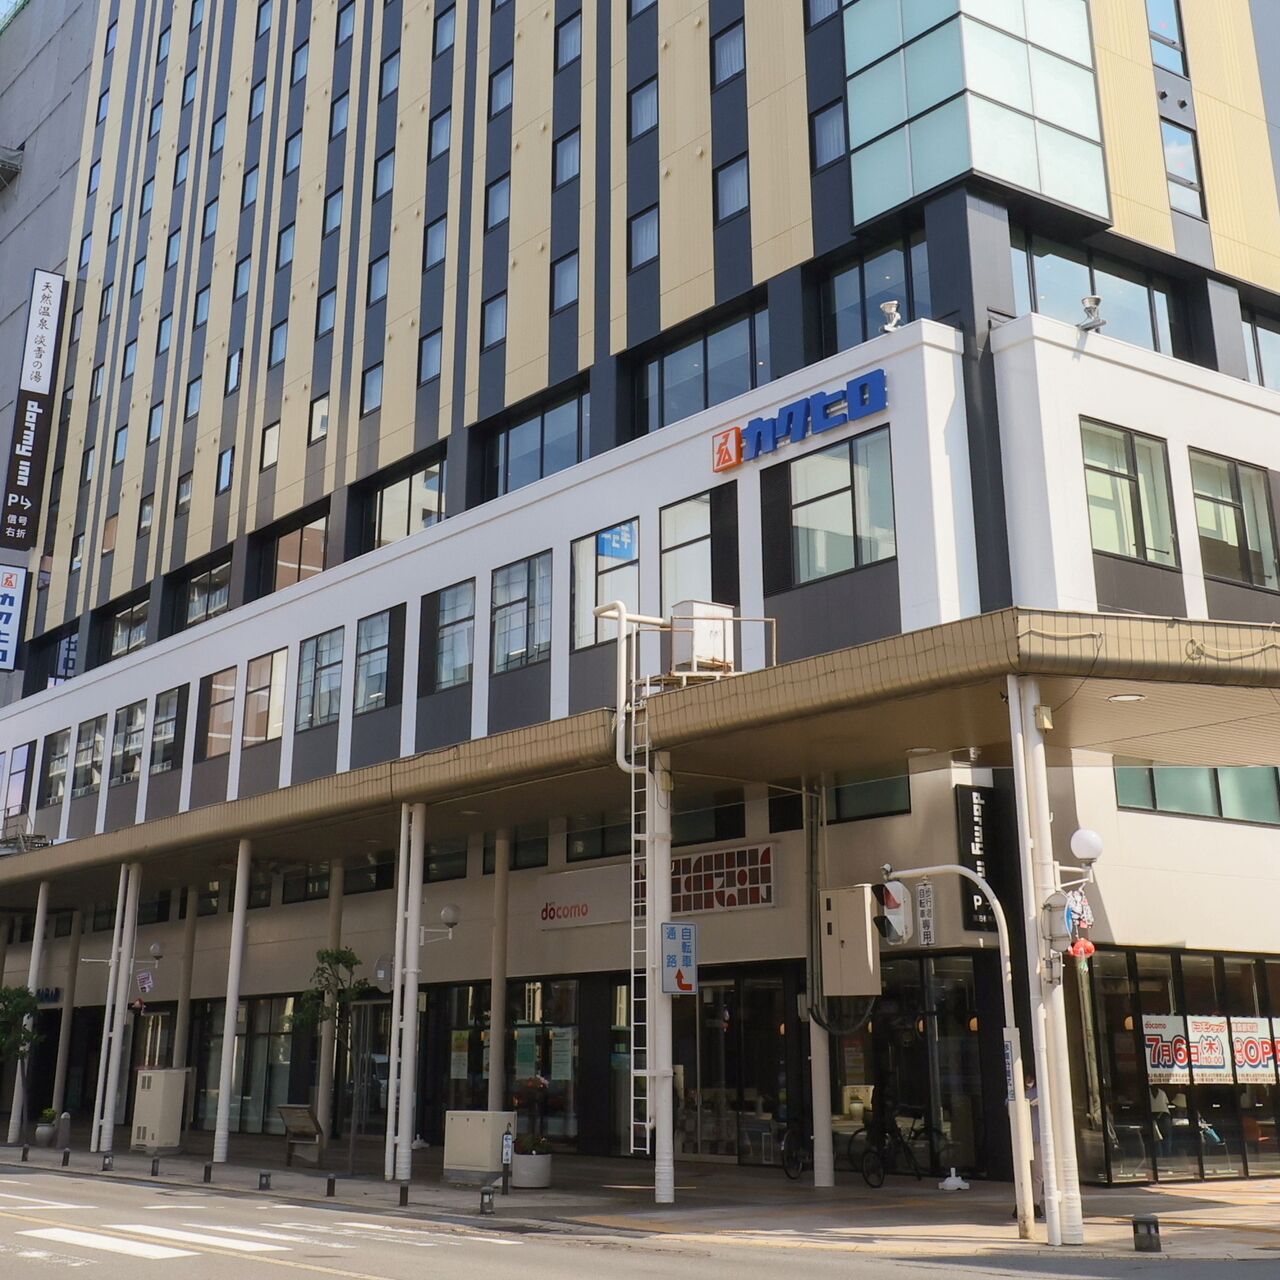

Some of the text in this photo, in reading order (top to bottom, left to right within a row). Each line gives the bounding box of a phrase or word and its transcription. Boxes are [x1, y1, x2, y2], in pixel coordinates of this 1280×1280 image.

[30, 282, 53, 383] 天然温泉 淡雪の湯
[741, 369, 888, 461] カクヒロ
[15, 400, 43, 487] dormy inn
[7, 493, 19, 507] P
[7, 513, 28, 526] 信号
[5, 526, 27, 539] 右折
[971, 792, 985, 855] dormy
[541, 901, 589, 921] docomo
[973, 895, 982, 911] P
[666, 927, 677, 967] 通路
[681, 927, 692, 967] 自転車
